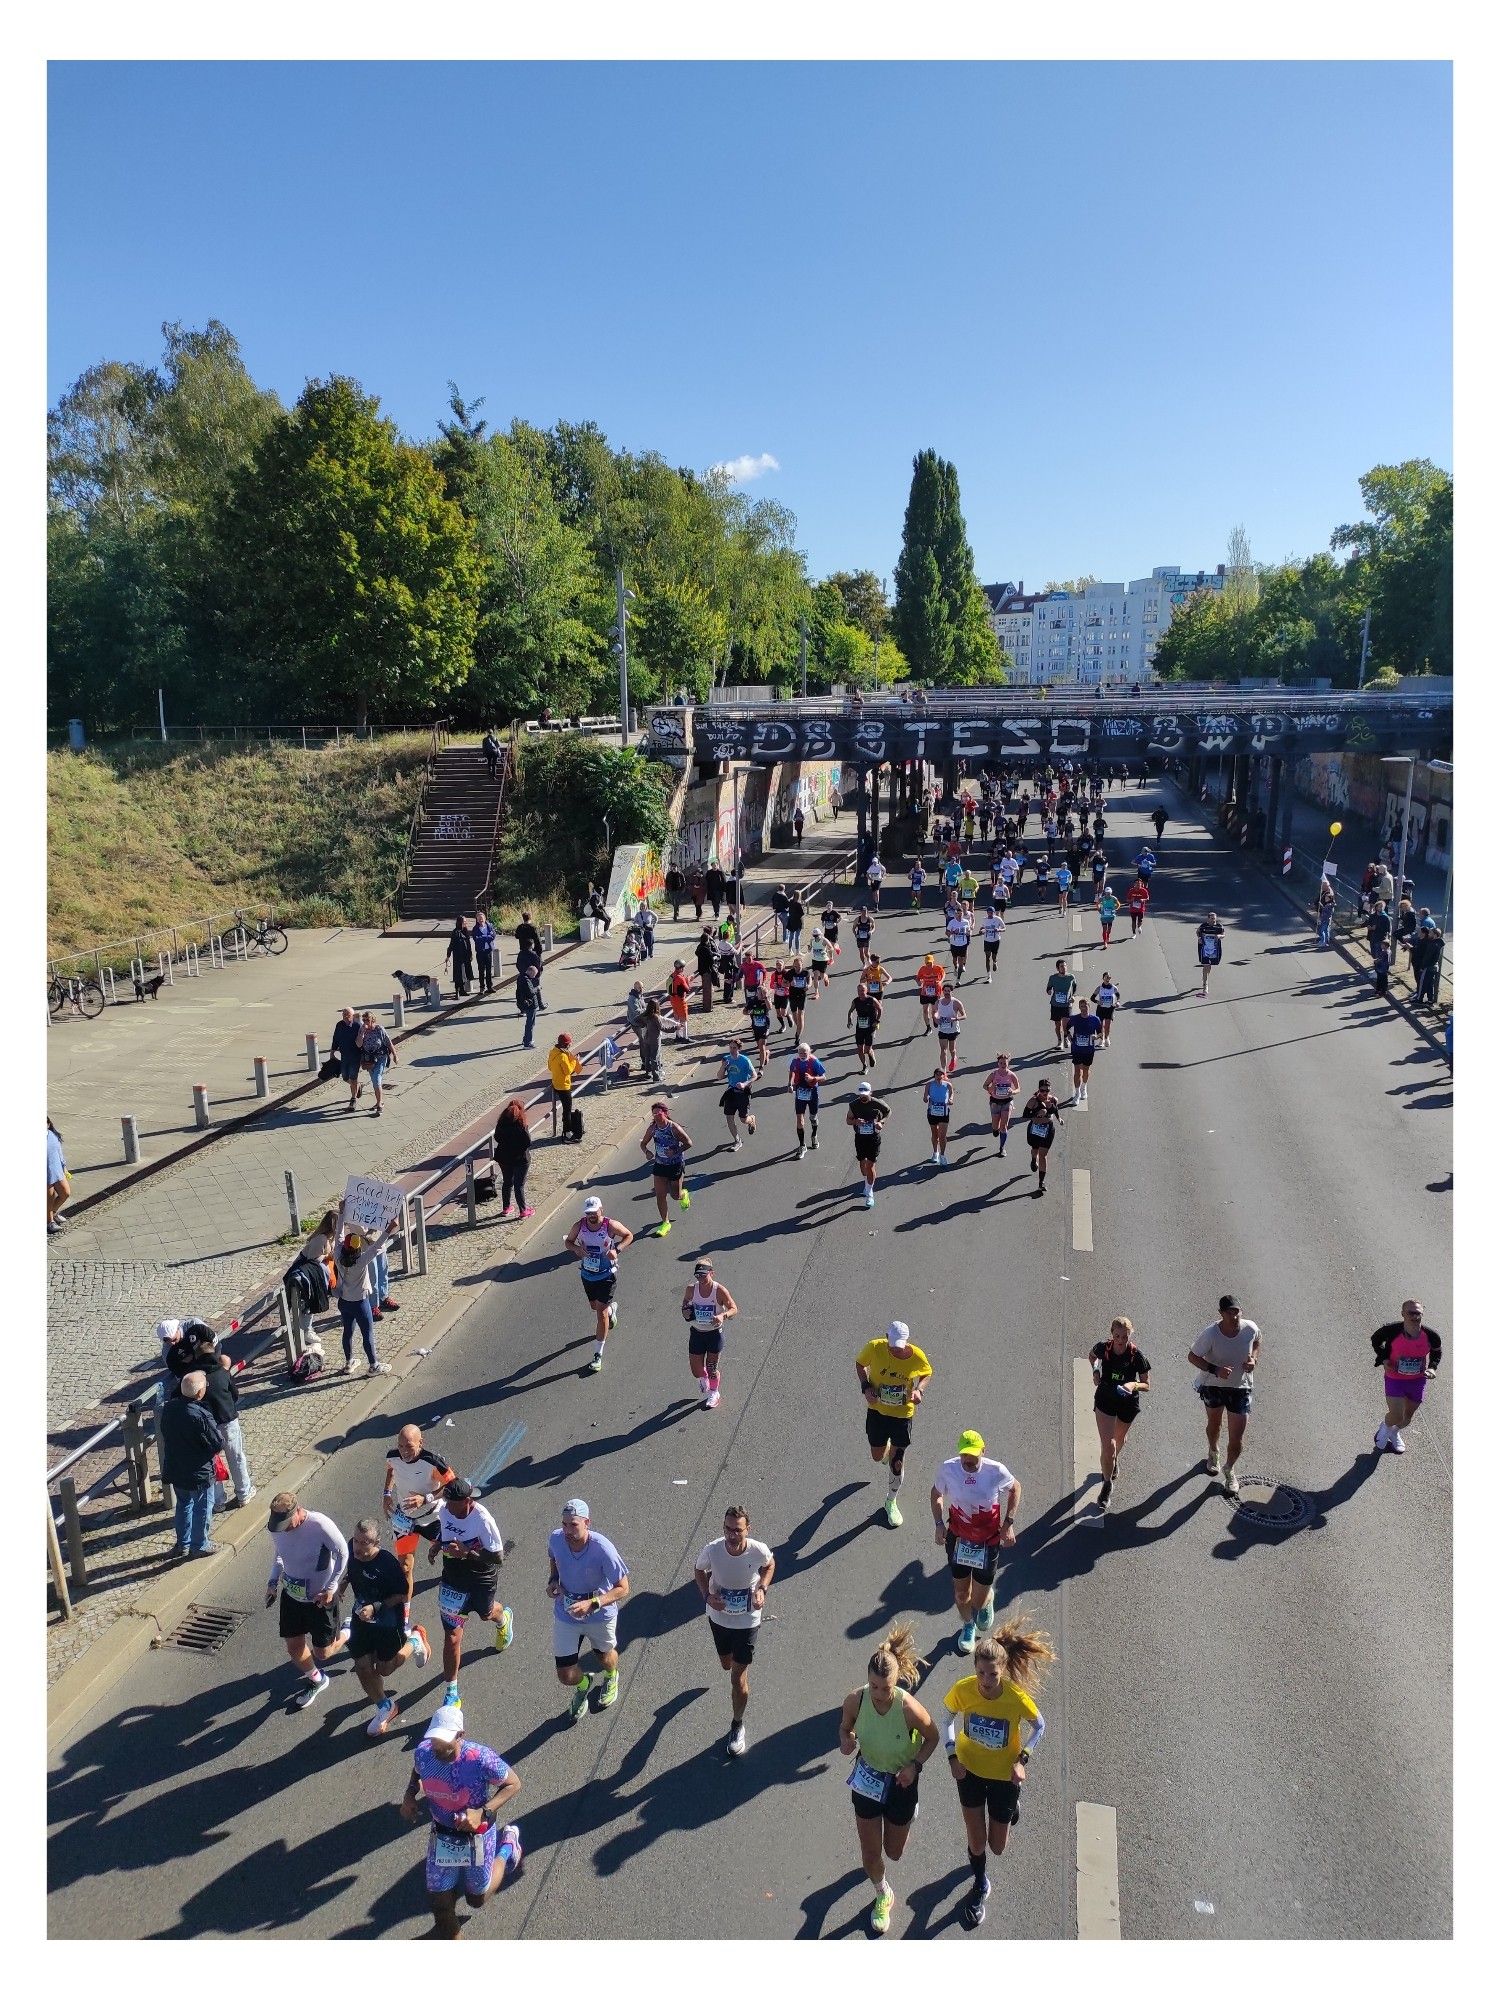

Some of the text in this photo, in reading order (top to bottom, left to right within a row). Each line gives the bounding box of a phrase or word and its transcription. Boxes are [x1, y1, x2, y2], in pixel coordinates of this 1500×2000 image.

[357, 1183, 402, 1205] Good luck
[382, 1203, 399, 1217] your
[444, 1520, 467, 1537] Zoot
[441, 1588, 463, 1601] 89103
[972, 1726, 1001, 1739] 68512
[441, 1841, 466, 1853] 32217
